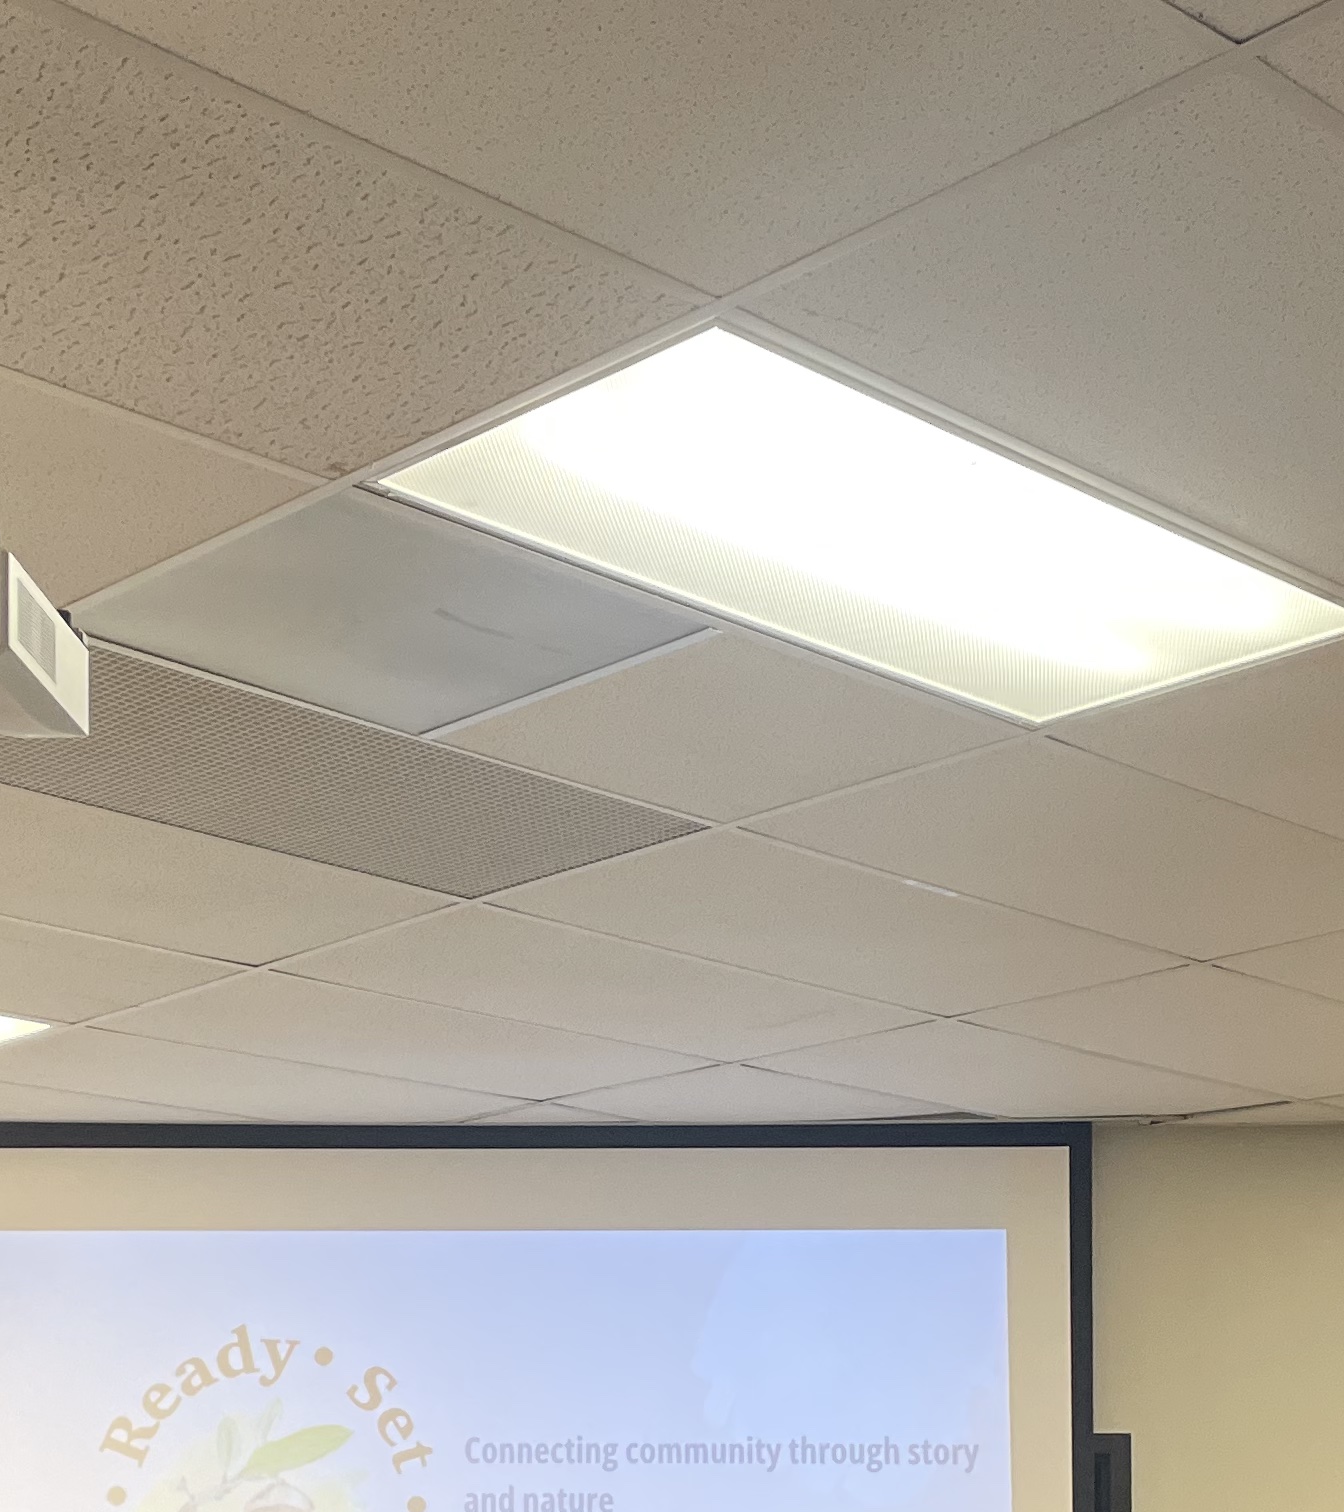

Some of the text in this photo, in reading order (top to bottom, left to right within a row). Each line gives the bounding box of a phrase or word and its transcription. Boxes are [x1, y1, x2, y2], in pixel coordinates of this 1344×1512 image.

[98, 1323, 434, 1475] Ready Set
[464, 1435, 980, 1474] Connecting community through story
